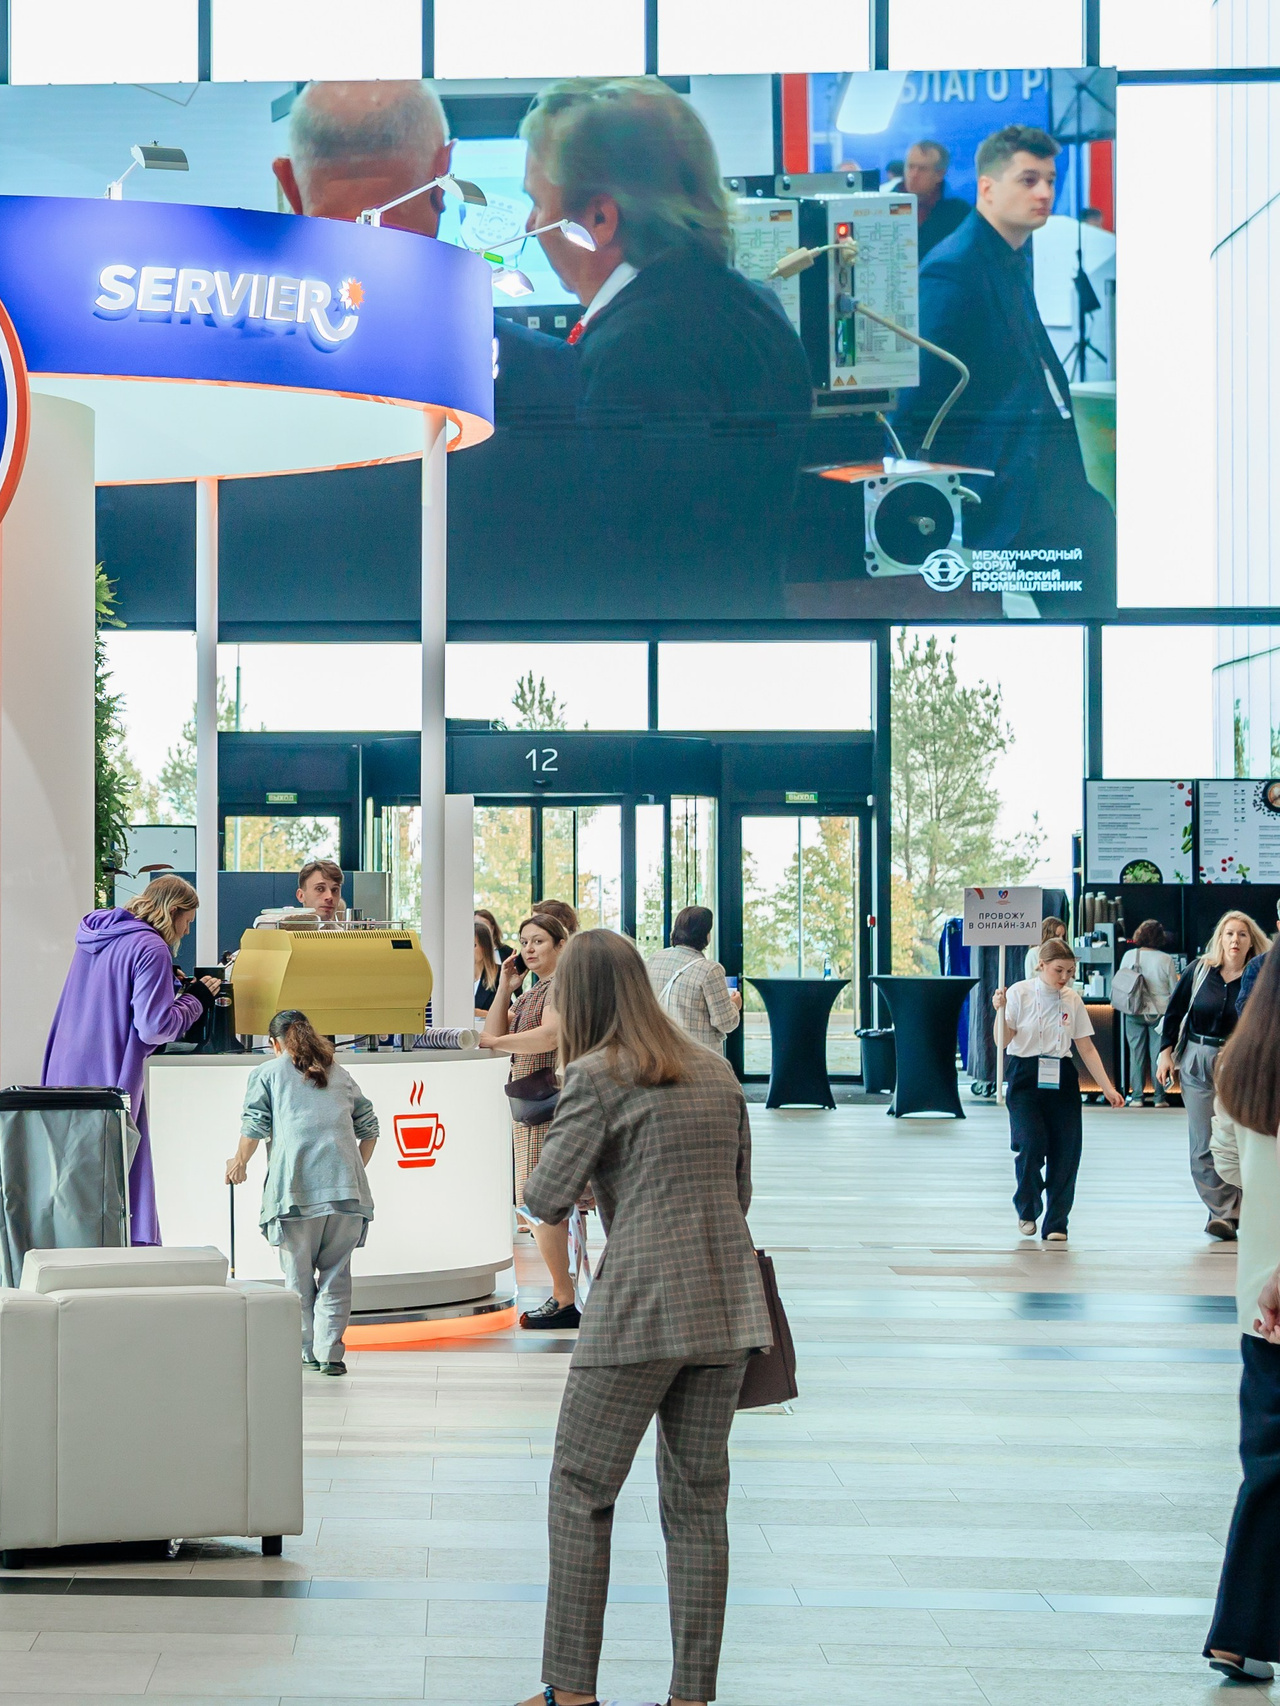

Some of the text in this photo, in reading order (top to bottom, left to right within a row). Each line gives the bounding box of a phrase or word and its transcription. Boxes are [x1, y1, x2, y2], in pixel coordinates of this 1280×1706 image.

[95, 264, 360, 342] SERVIER
[972, 548, 1083, 561] МЕЖДУНАРОДНЫЙ
[972, 561, 1017, 571] ФОРУМ
[972, 569, 1061, 581] РОССИЙСКИЙ
[972, 580, 1083, 592] ПРОМЫШЛЕННИК
[525, 748, 559, 772] 12
[978, 912, 1025, 920] ПРОВОЖУ
[968, 920, 1037, 930] В ОНЛАЙН-ЗАЛ
